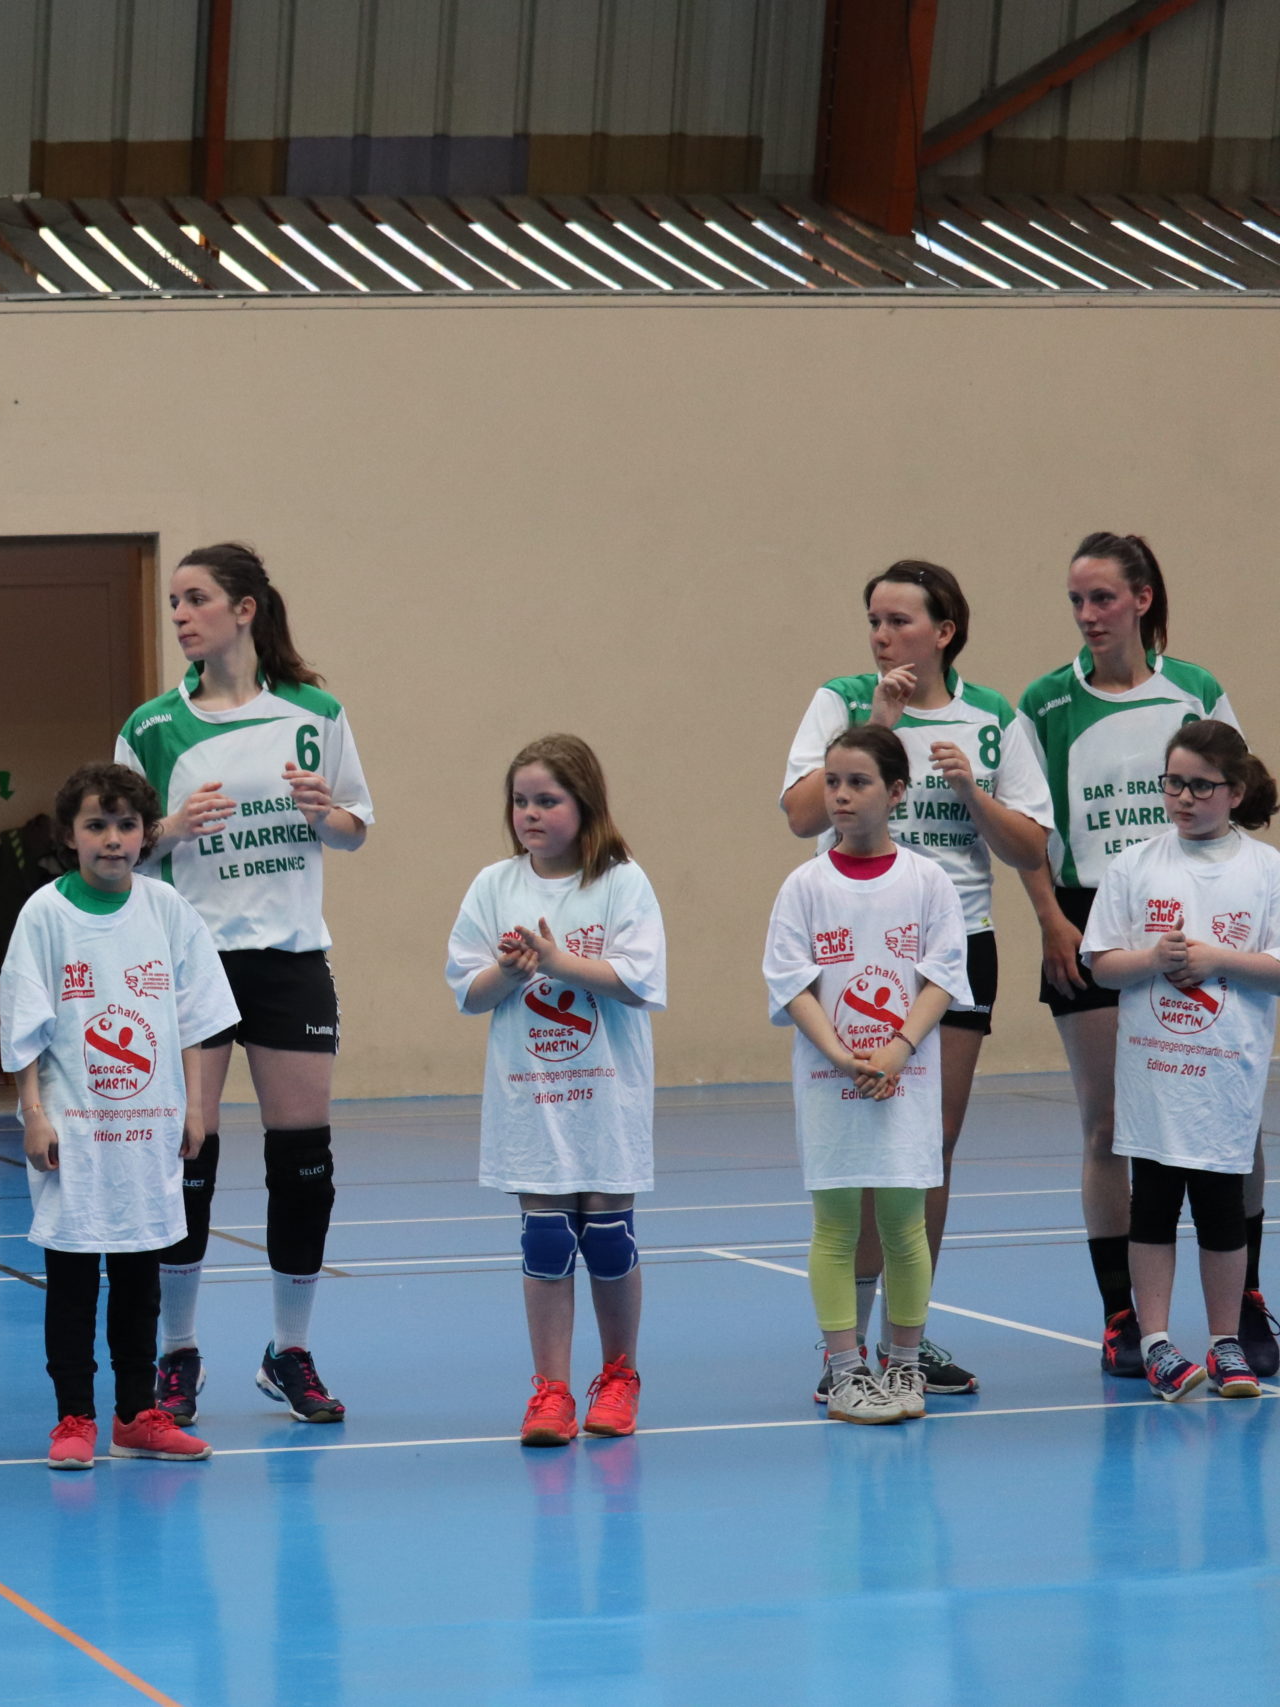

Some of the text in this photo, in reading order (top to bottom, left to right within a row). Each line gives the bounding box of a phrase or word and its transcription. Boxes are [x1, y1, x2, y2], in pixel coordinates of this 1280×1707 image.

[295, 724, 320, 772] 6
[978, 724, 1001, 770] 8
[1083, 784, 1115, 801] BAR
[1086, 811, 1111, 831] LE
[198, 834, 225, 856] LE
[1105, 839, 1122, 855] LE
[219, 865, 240, 880] LE
[1148, 897, 1181, 913] equip
[1150, 909, 1175, 922] club
[816, 926, 850, 942] equip
[821, 939, 847, 955] club
[865, 965, 910, 1008] Challenge
[1159, 996, 1203, 1012] GEORGES
[107, 1003, 158, 1048] Challenge
[1161, 1011, 1204, 1028] MARTIN
[529, 1027, 576, 1039] GEORGES
[847, 1024, 892, 1034] GEORGES
[534, 1040, 579, 1053] MARTIN
[89, 1064, 135, 1075] GEORGES
[1147, 1058, 1207, 1077] Edition 2015
[94, 1078, 138, 1090] MARTIN
[533, 1088, 593, 1104] dition 2015
[125, 1129, 153, 1141] 2015
